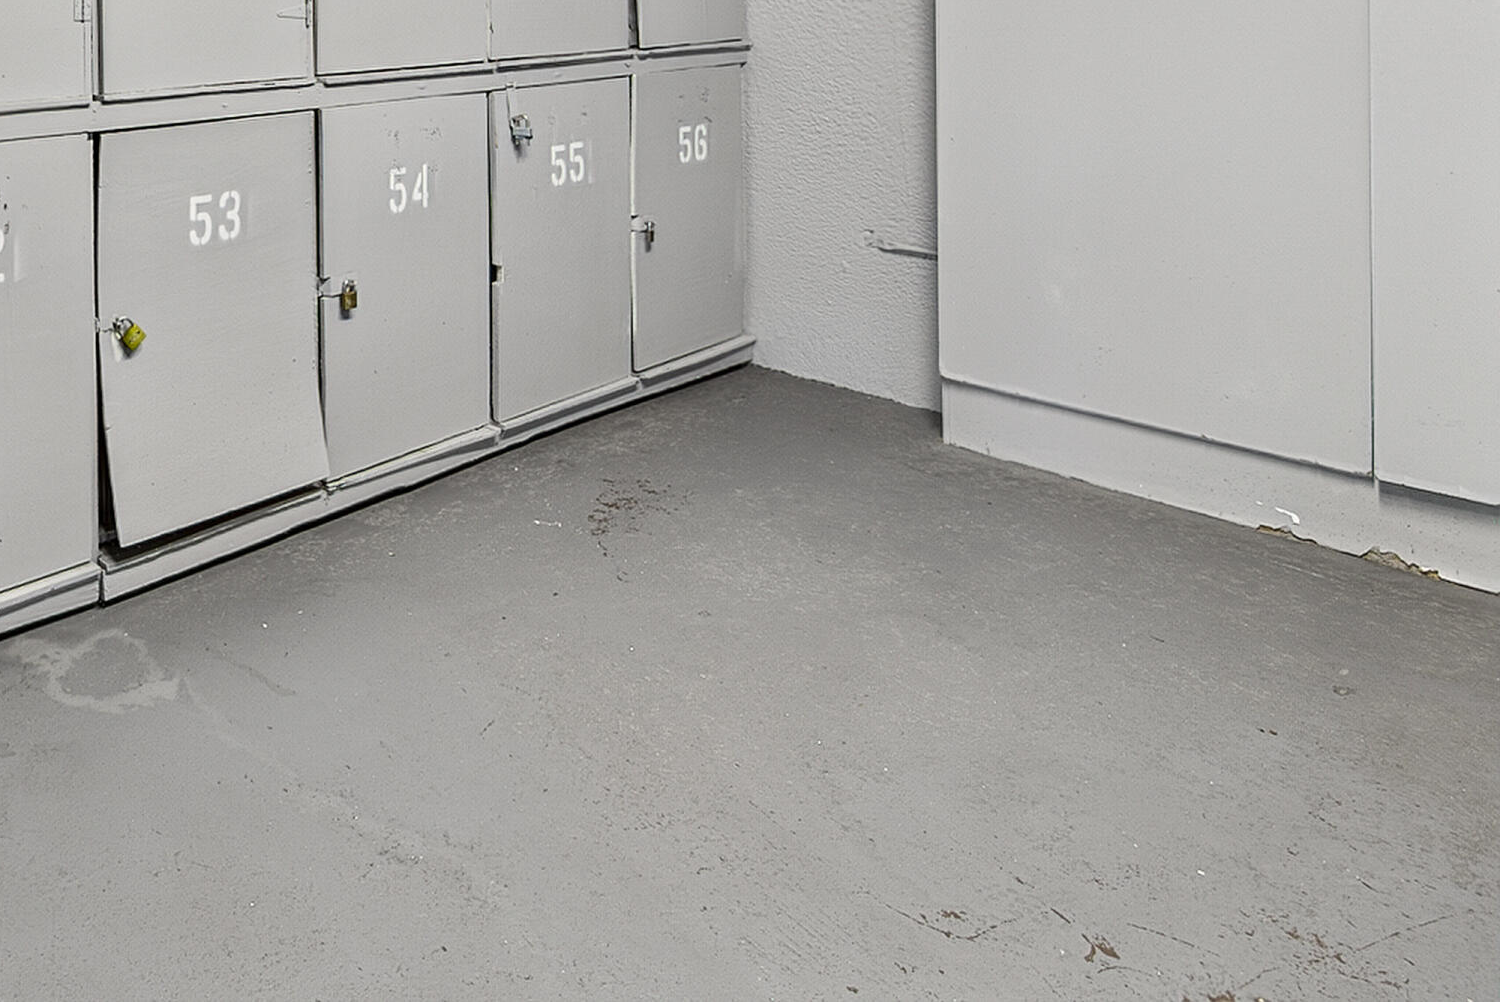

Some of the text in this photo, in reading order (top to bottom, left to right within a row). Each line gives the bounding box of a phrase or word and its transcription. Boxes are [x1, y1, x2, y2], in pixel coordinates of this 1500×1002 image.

[550, 141, 586, 186] 55
[678, 123, 709, 165] 56
[389, 163, 430, 215] 54
[188, 190, 242, 246] 53
